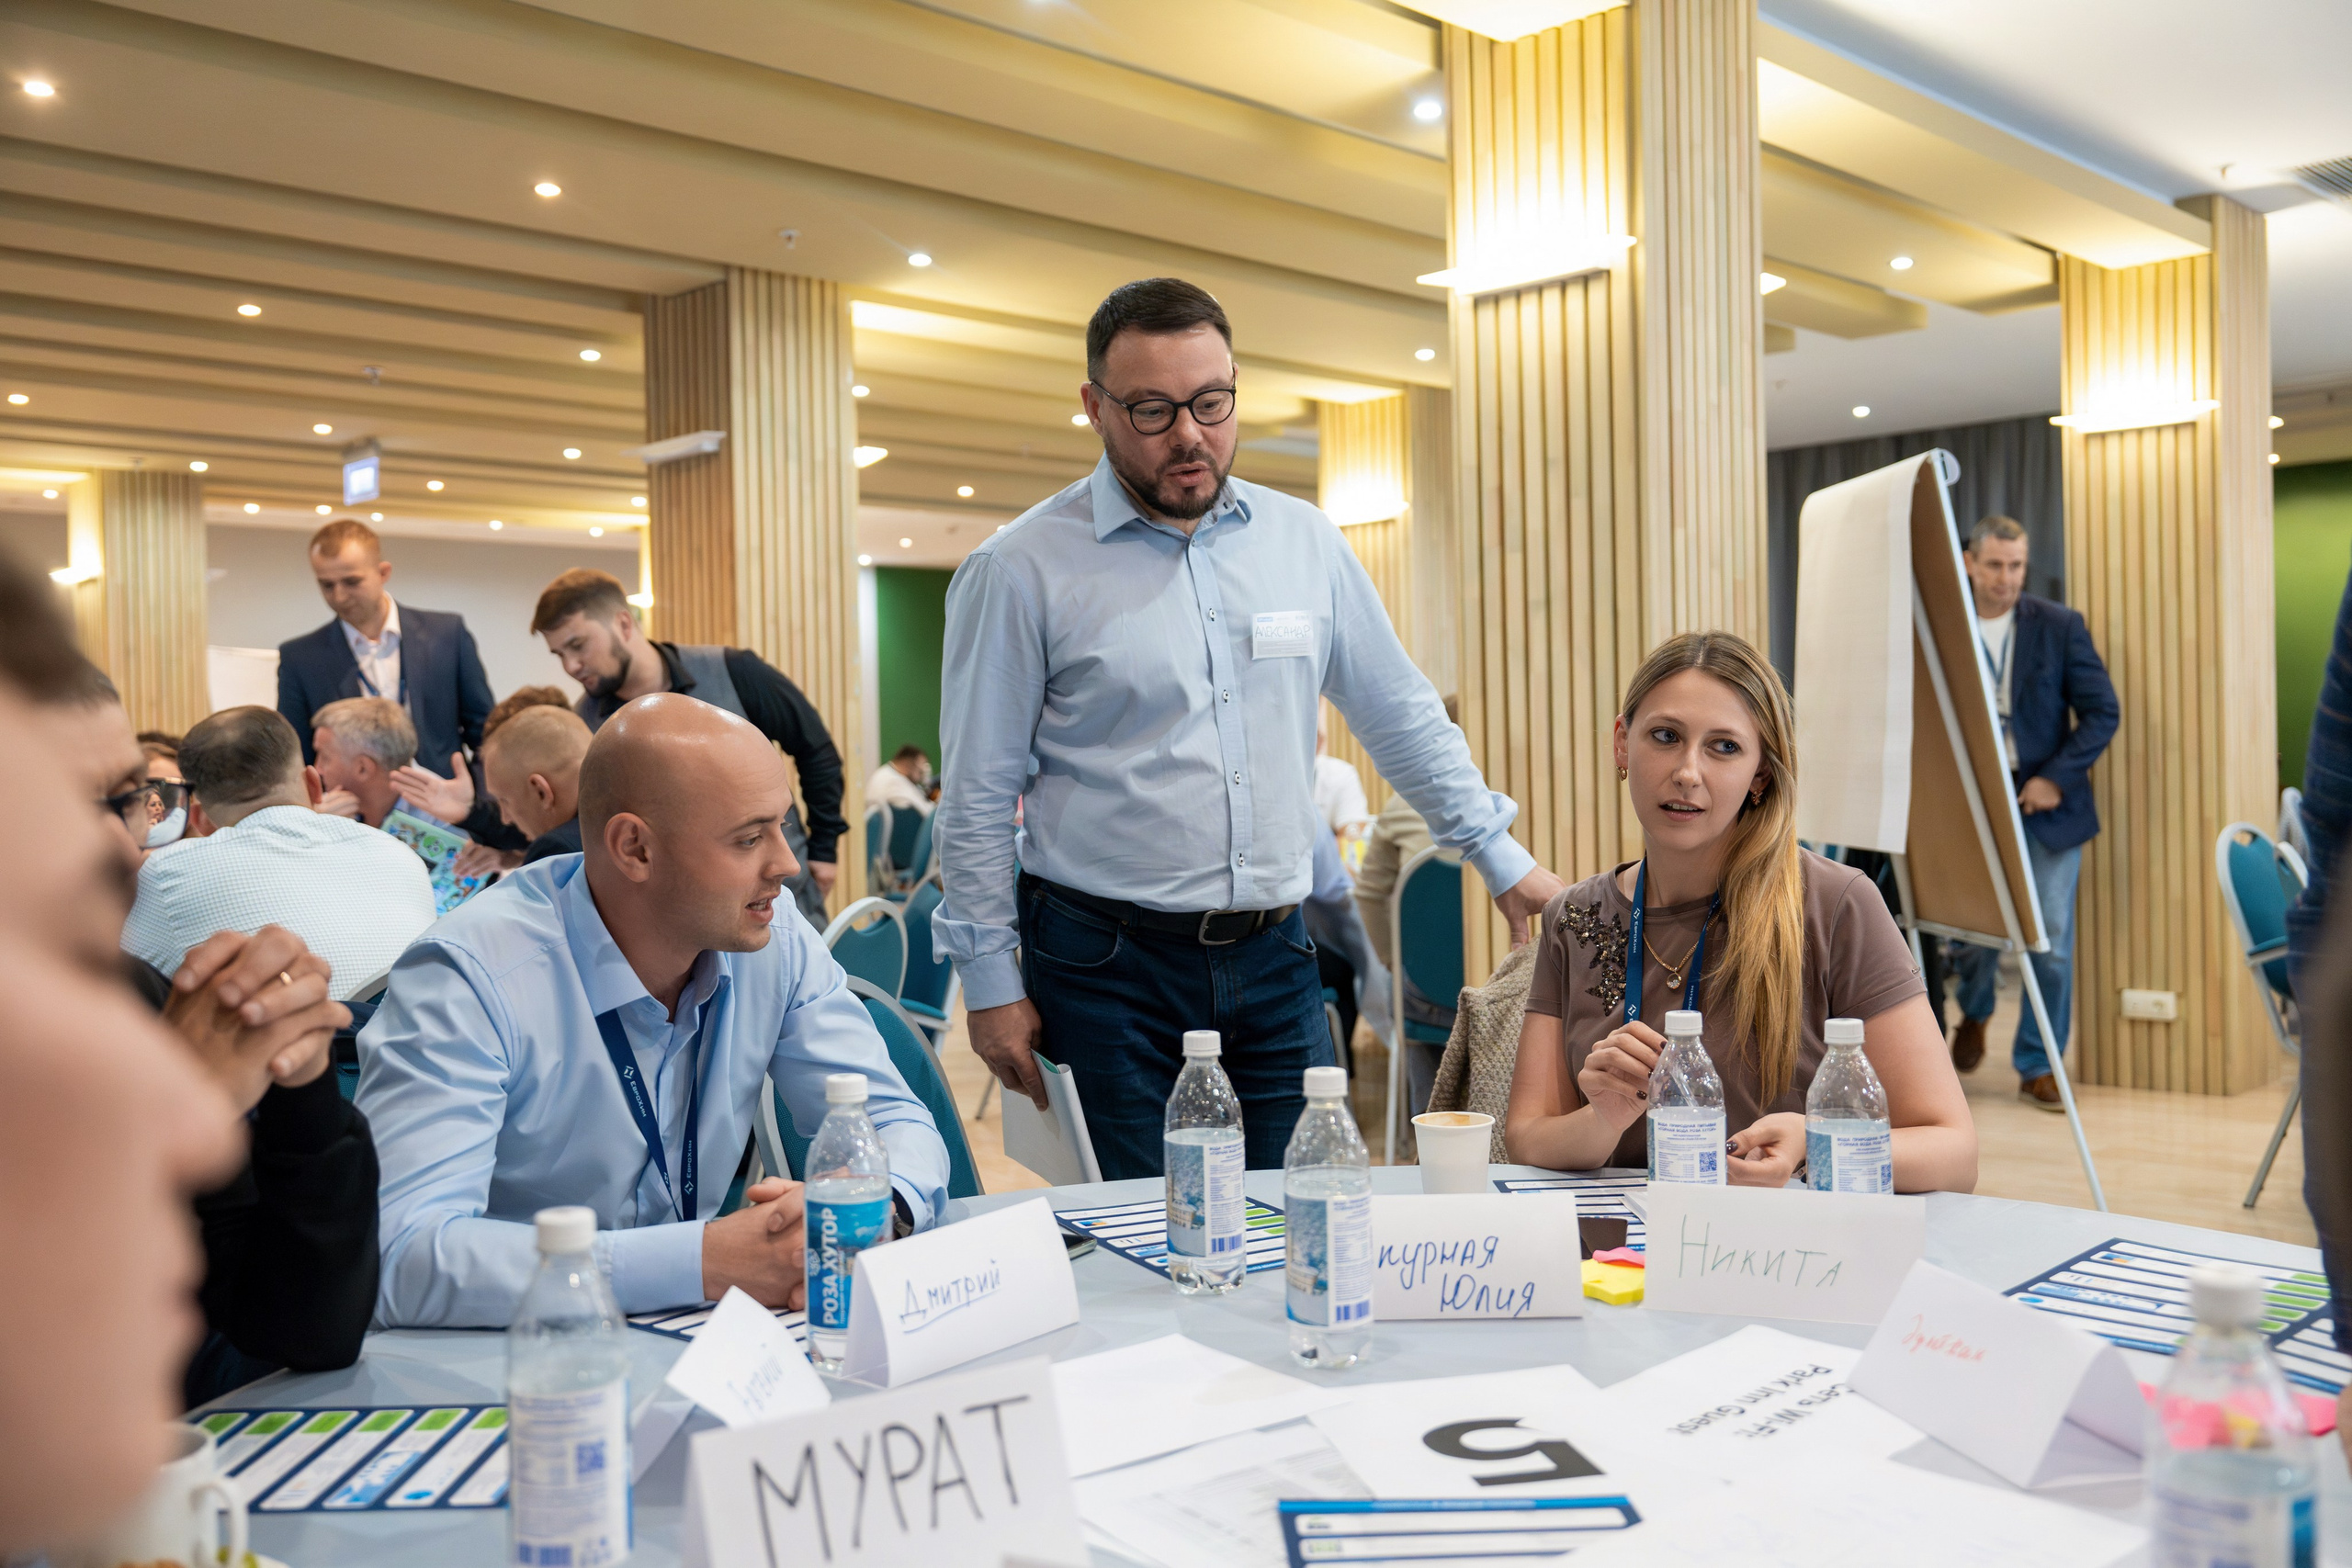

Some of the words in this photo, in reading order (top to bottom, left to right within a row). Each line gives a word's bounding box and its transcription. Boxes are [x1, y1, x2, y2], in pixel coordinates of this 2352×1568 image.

[820, 1207, 839, 1273] ХУТОР
[1679, 1214, 1842, 1287] Никита
[822, 1274, 839, 1325] РОЗА
[899, 1258, 1001, 1325] Дмитрий
[1440, 1273, 1535, 1317] Юлия
[1735, 1385, 1787, 1404] Inn
[1770, 1363, 1834, 1387] Park
[1667, 1404, 1746, 1435] Guest
[752, 1394, 1032, 1567] МУРАТ
[1422, 1417, 1607, 1486] 5
